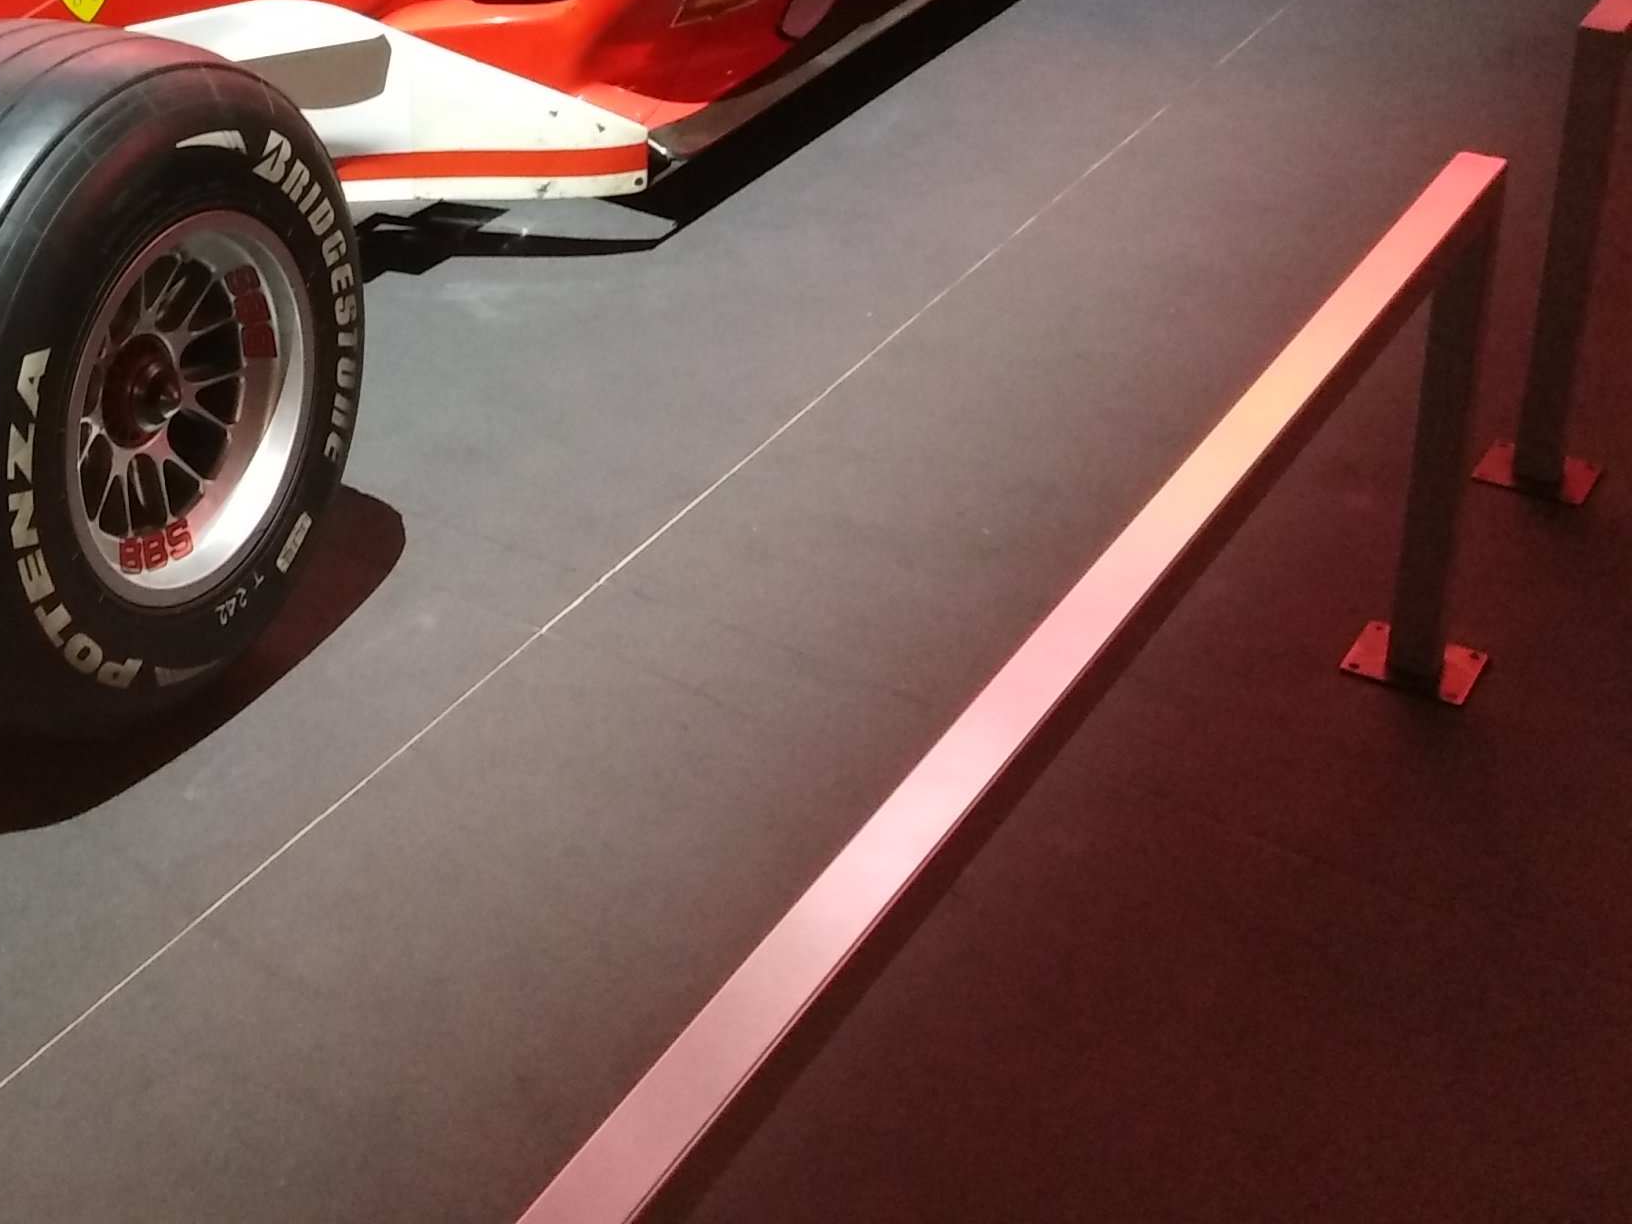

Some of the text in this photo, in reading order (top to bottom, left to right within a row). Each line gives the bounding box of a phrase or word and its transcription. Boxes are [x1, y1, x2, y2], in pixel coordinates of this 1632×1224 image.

[253, 129, 358, 464] BRIDGESTONE
[7, 347, 144, 689] POTENZA
[119, 517, 194, 574] BBS
